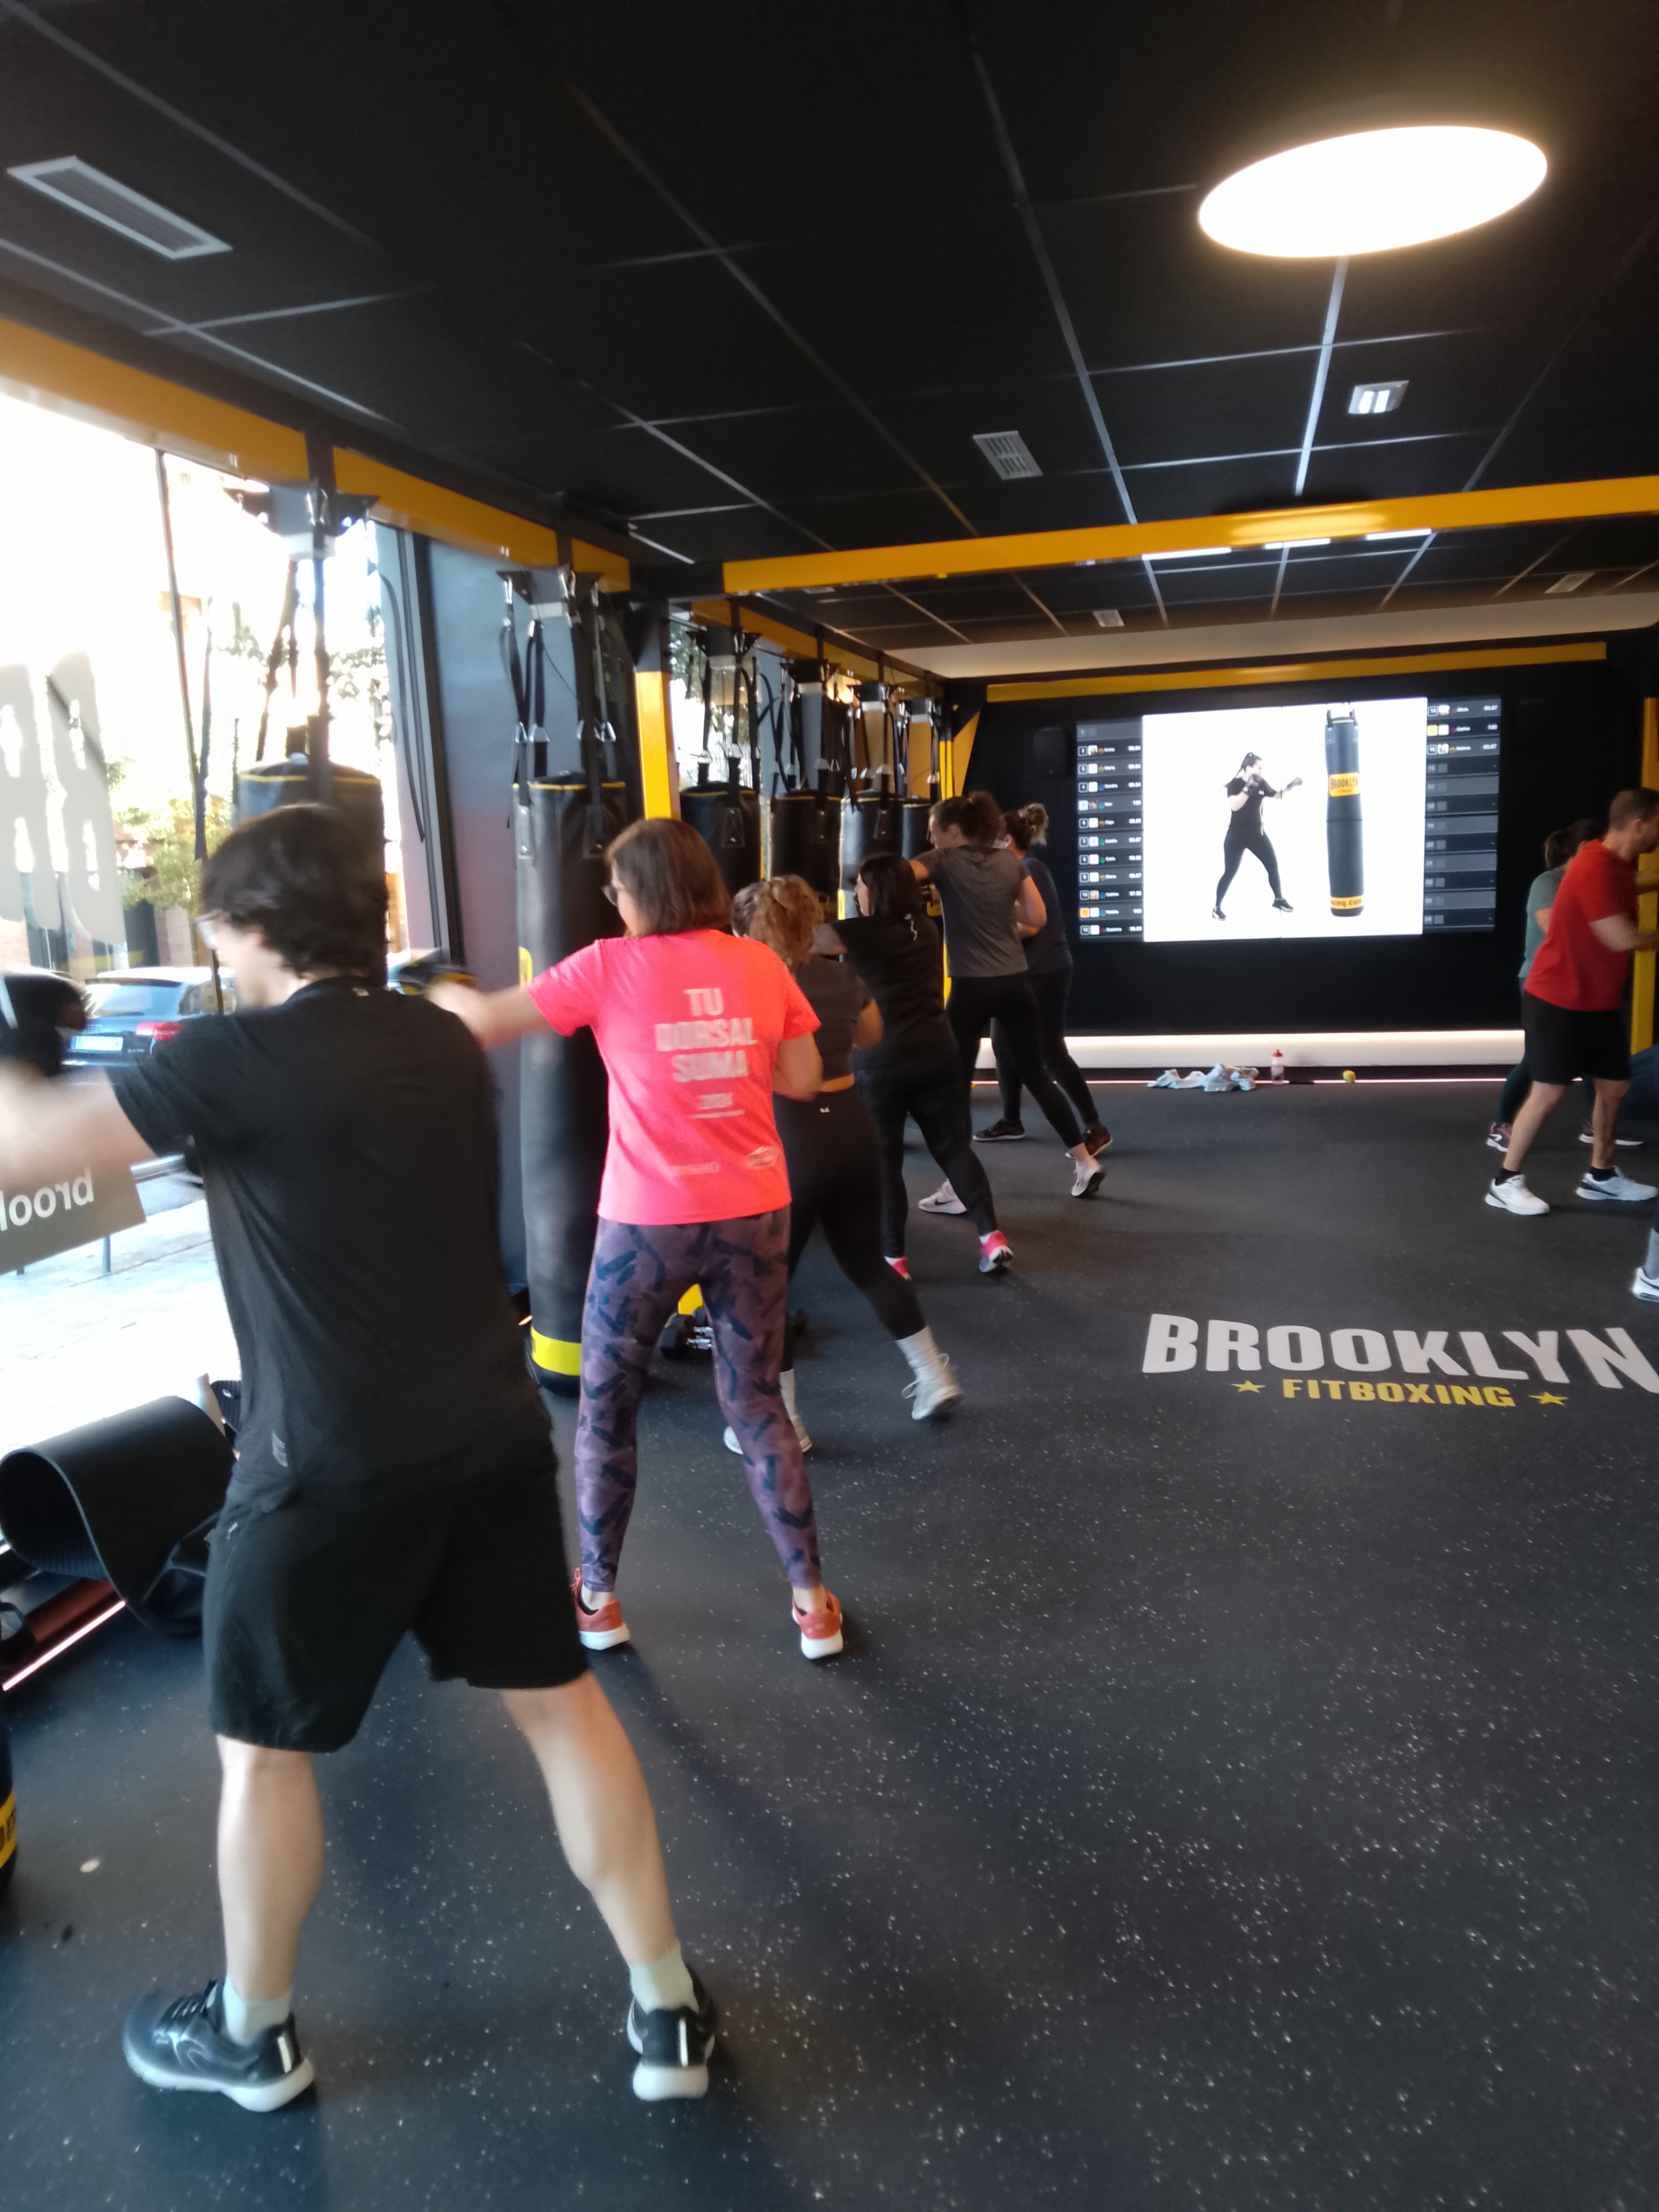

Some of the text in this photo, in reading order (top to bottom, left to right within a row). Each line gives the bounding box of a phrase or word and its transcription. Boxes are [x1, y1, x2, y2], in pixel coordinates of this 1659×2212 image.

[684, 987, 724, 1017] TU
[1142, 1313, 1659, 1393] BROOKLYN
[1282, 1378, 1516, 1407] FITBOXING
